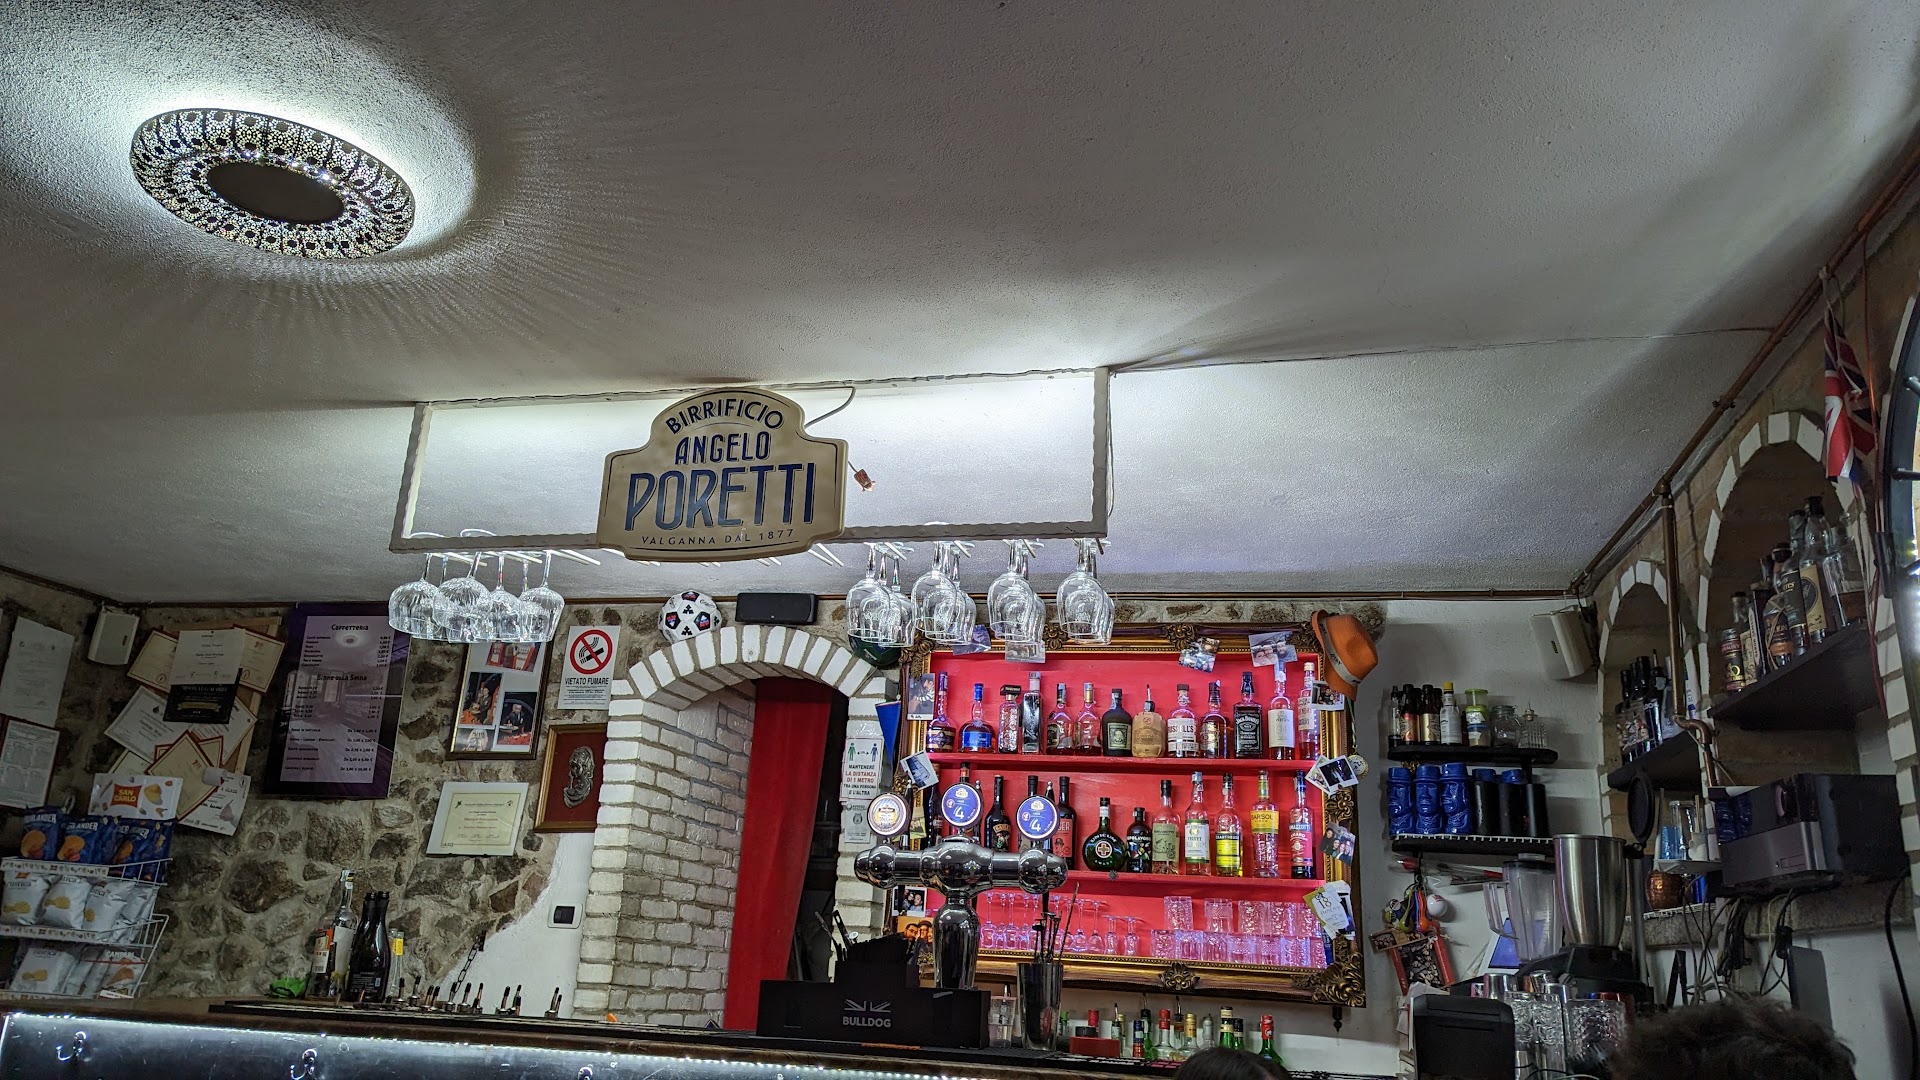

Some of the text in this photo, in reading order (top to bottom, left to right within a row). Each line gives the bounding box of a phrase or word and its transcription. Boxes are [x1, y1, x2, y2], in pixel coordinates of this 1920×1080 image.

[665, 398, 784, 436] BIRRIFICIO
[675, 431, 772, 466] ANGELO
[624, 462, 816, 532] PORETTI
[641, 528, 795, 546] VALGANNA DAL 1877
[564, 677, 610, 686] VIETATO FUMARE
[114, 795, 137, 803] CARLO
[118, 788, 135, 796] SAN
[955, 806, 965, 820] 4
[1031, 818, 1042, 832] 4
[1090, 833, 1118, 843] UNICUM
[842, 1016, 892, 1028] BULLDOG
